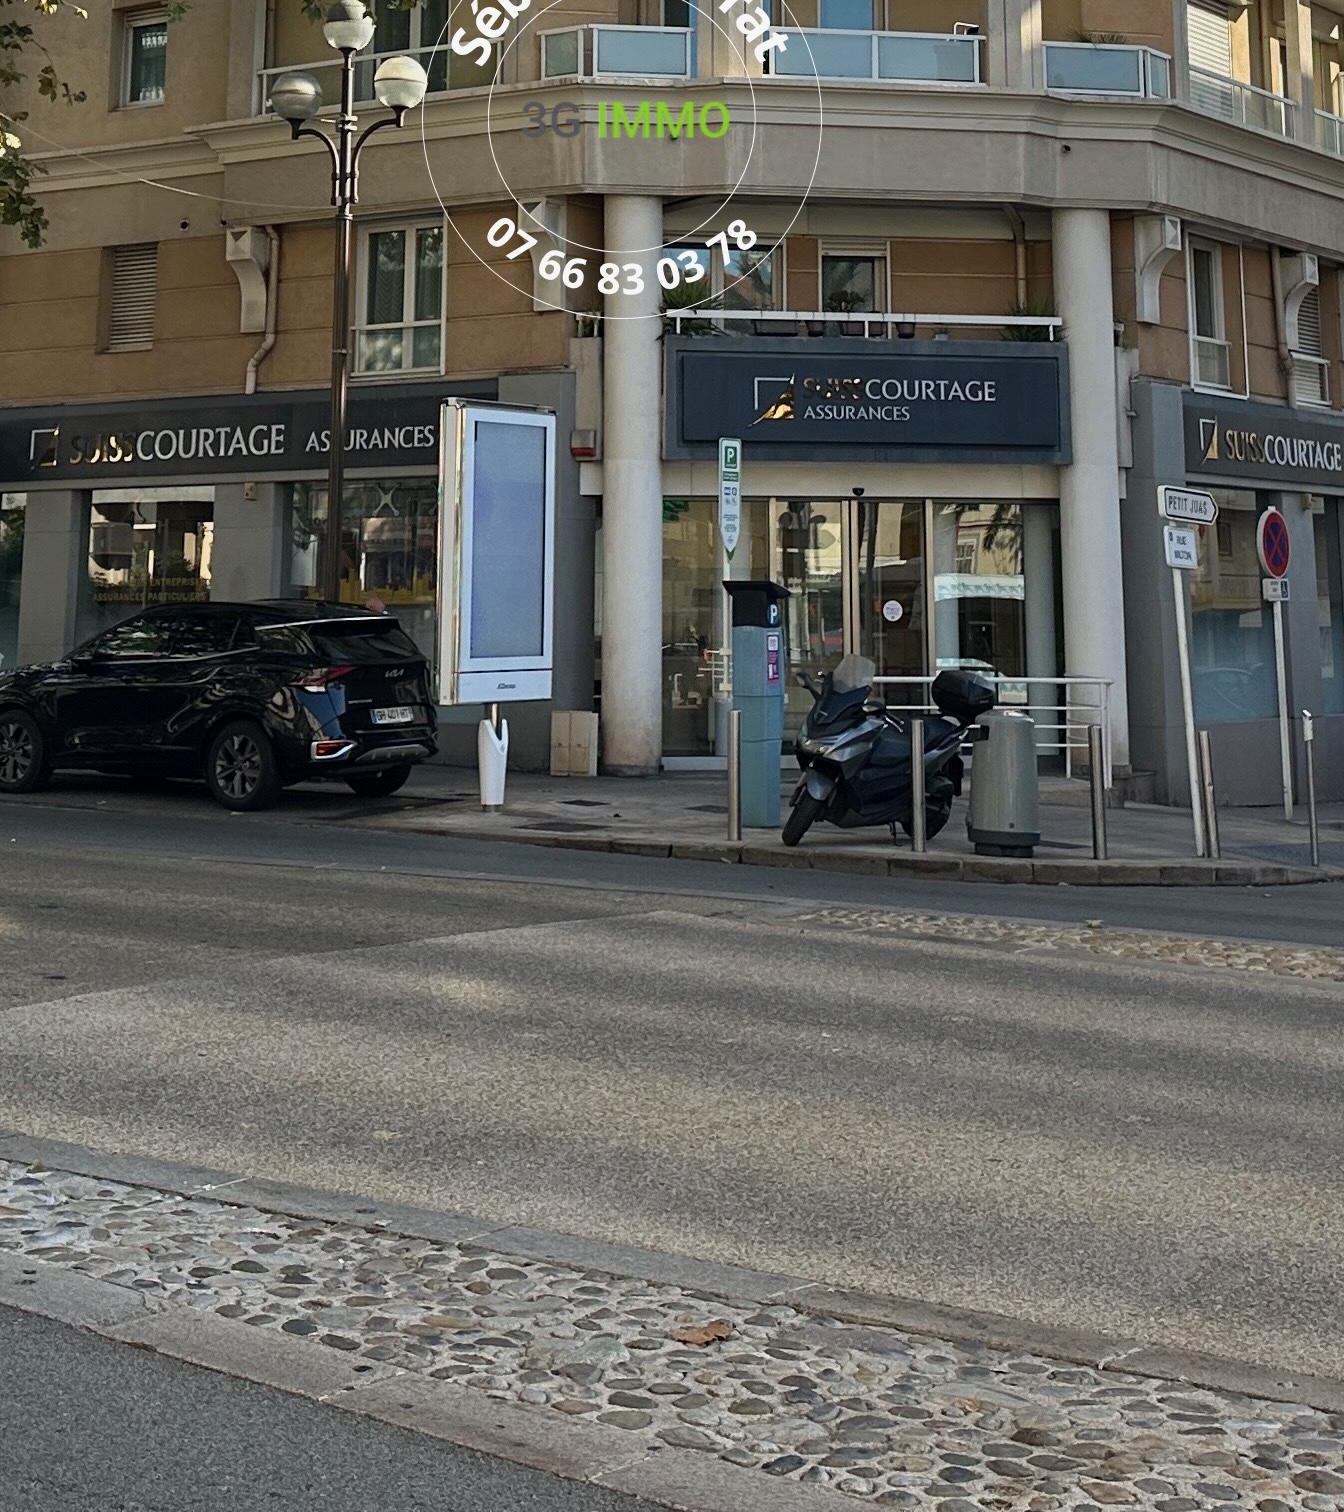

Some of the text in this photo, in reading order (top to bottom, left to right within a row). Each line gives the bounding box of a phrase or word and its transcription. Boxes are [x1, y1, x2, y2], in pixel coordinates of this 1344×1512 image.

[803, 405, 911, 422] ASSURANCES
[306, 425, 435, 453] ASURANCES
[1225, 429, 1343, 472] SUISSCOURTAGE
[1168, 495, 1208, 515] PETIT JUAS
[770, 604, 778, 624] P
